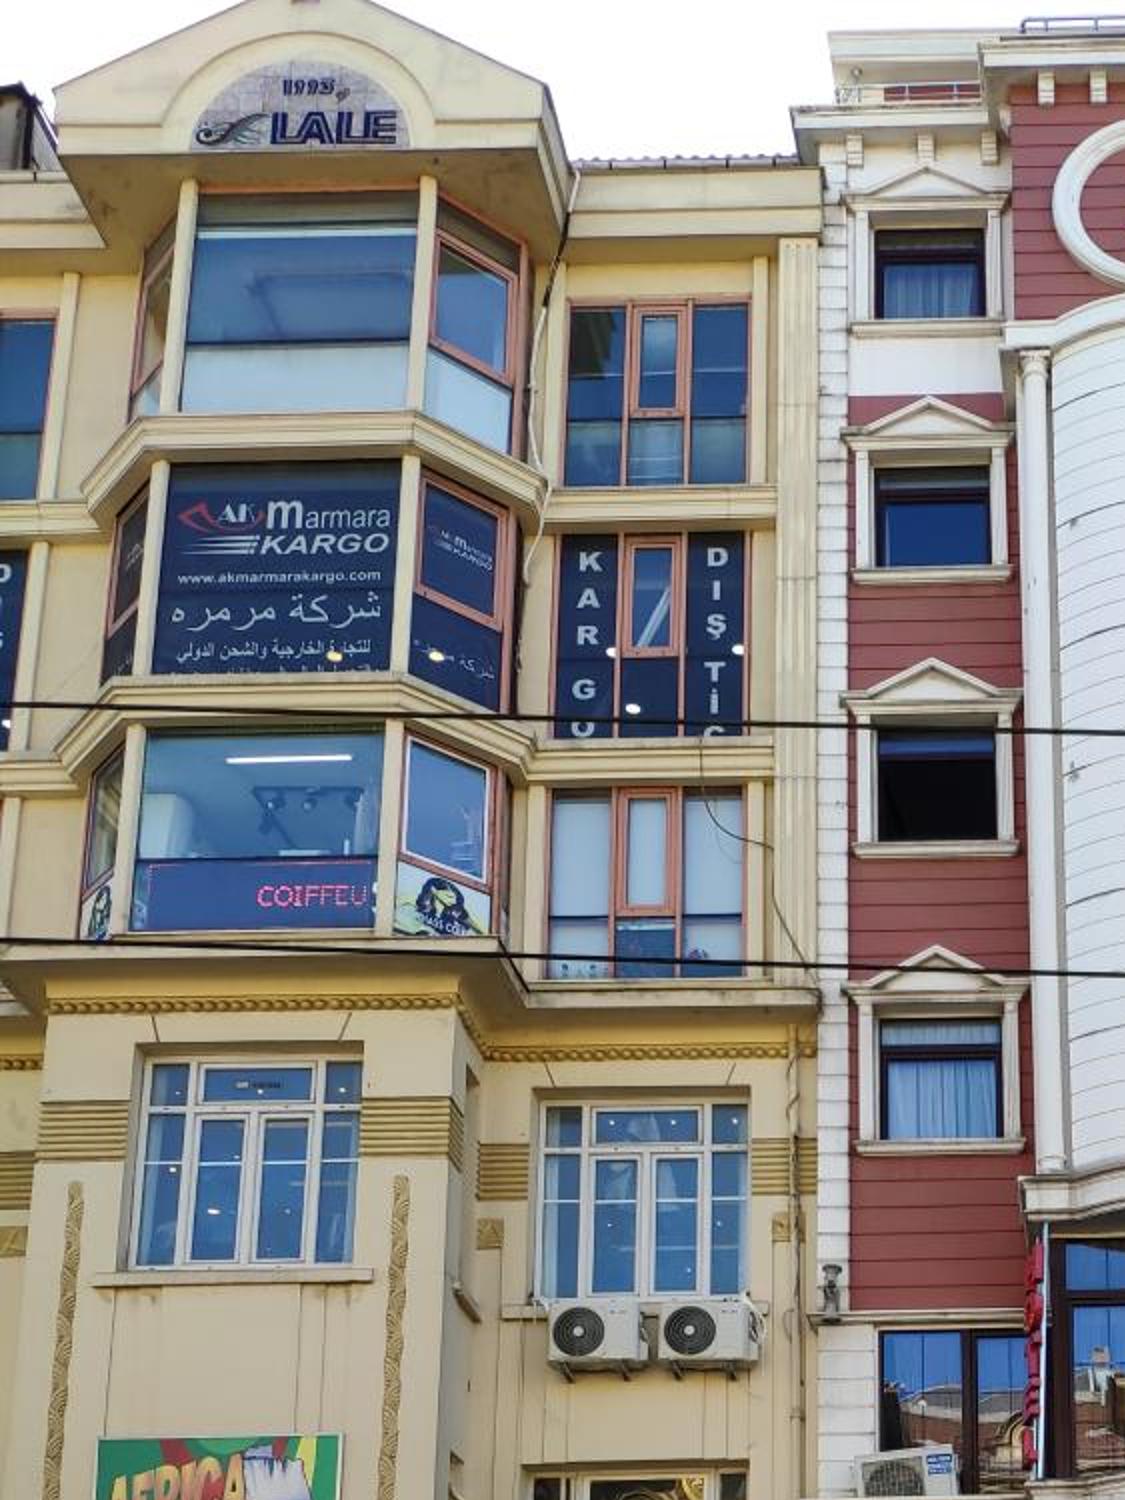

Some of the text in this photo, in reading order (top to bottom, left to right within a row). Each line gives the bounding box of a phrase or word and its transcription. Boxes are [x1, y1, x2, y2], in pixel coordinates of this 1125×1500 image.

[270, 110, 397, 145] LALE
[260, 533, 390, 555] KARGO
[177, 570, 382, 584] www.akmarmarakargo.com
[288, 590, 382, 629] شركة
